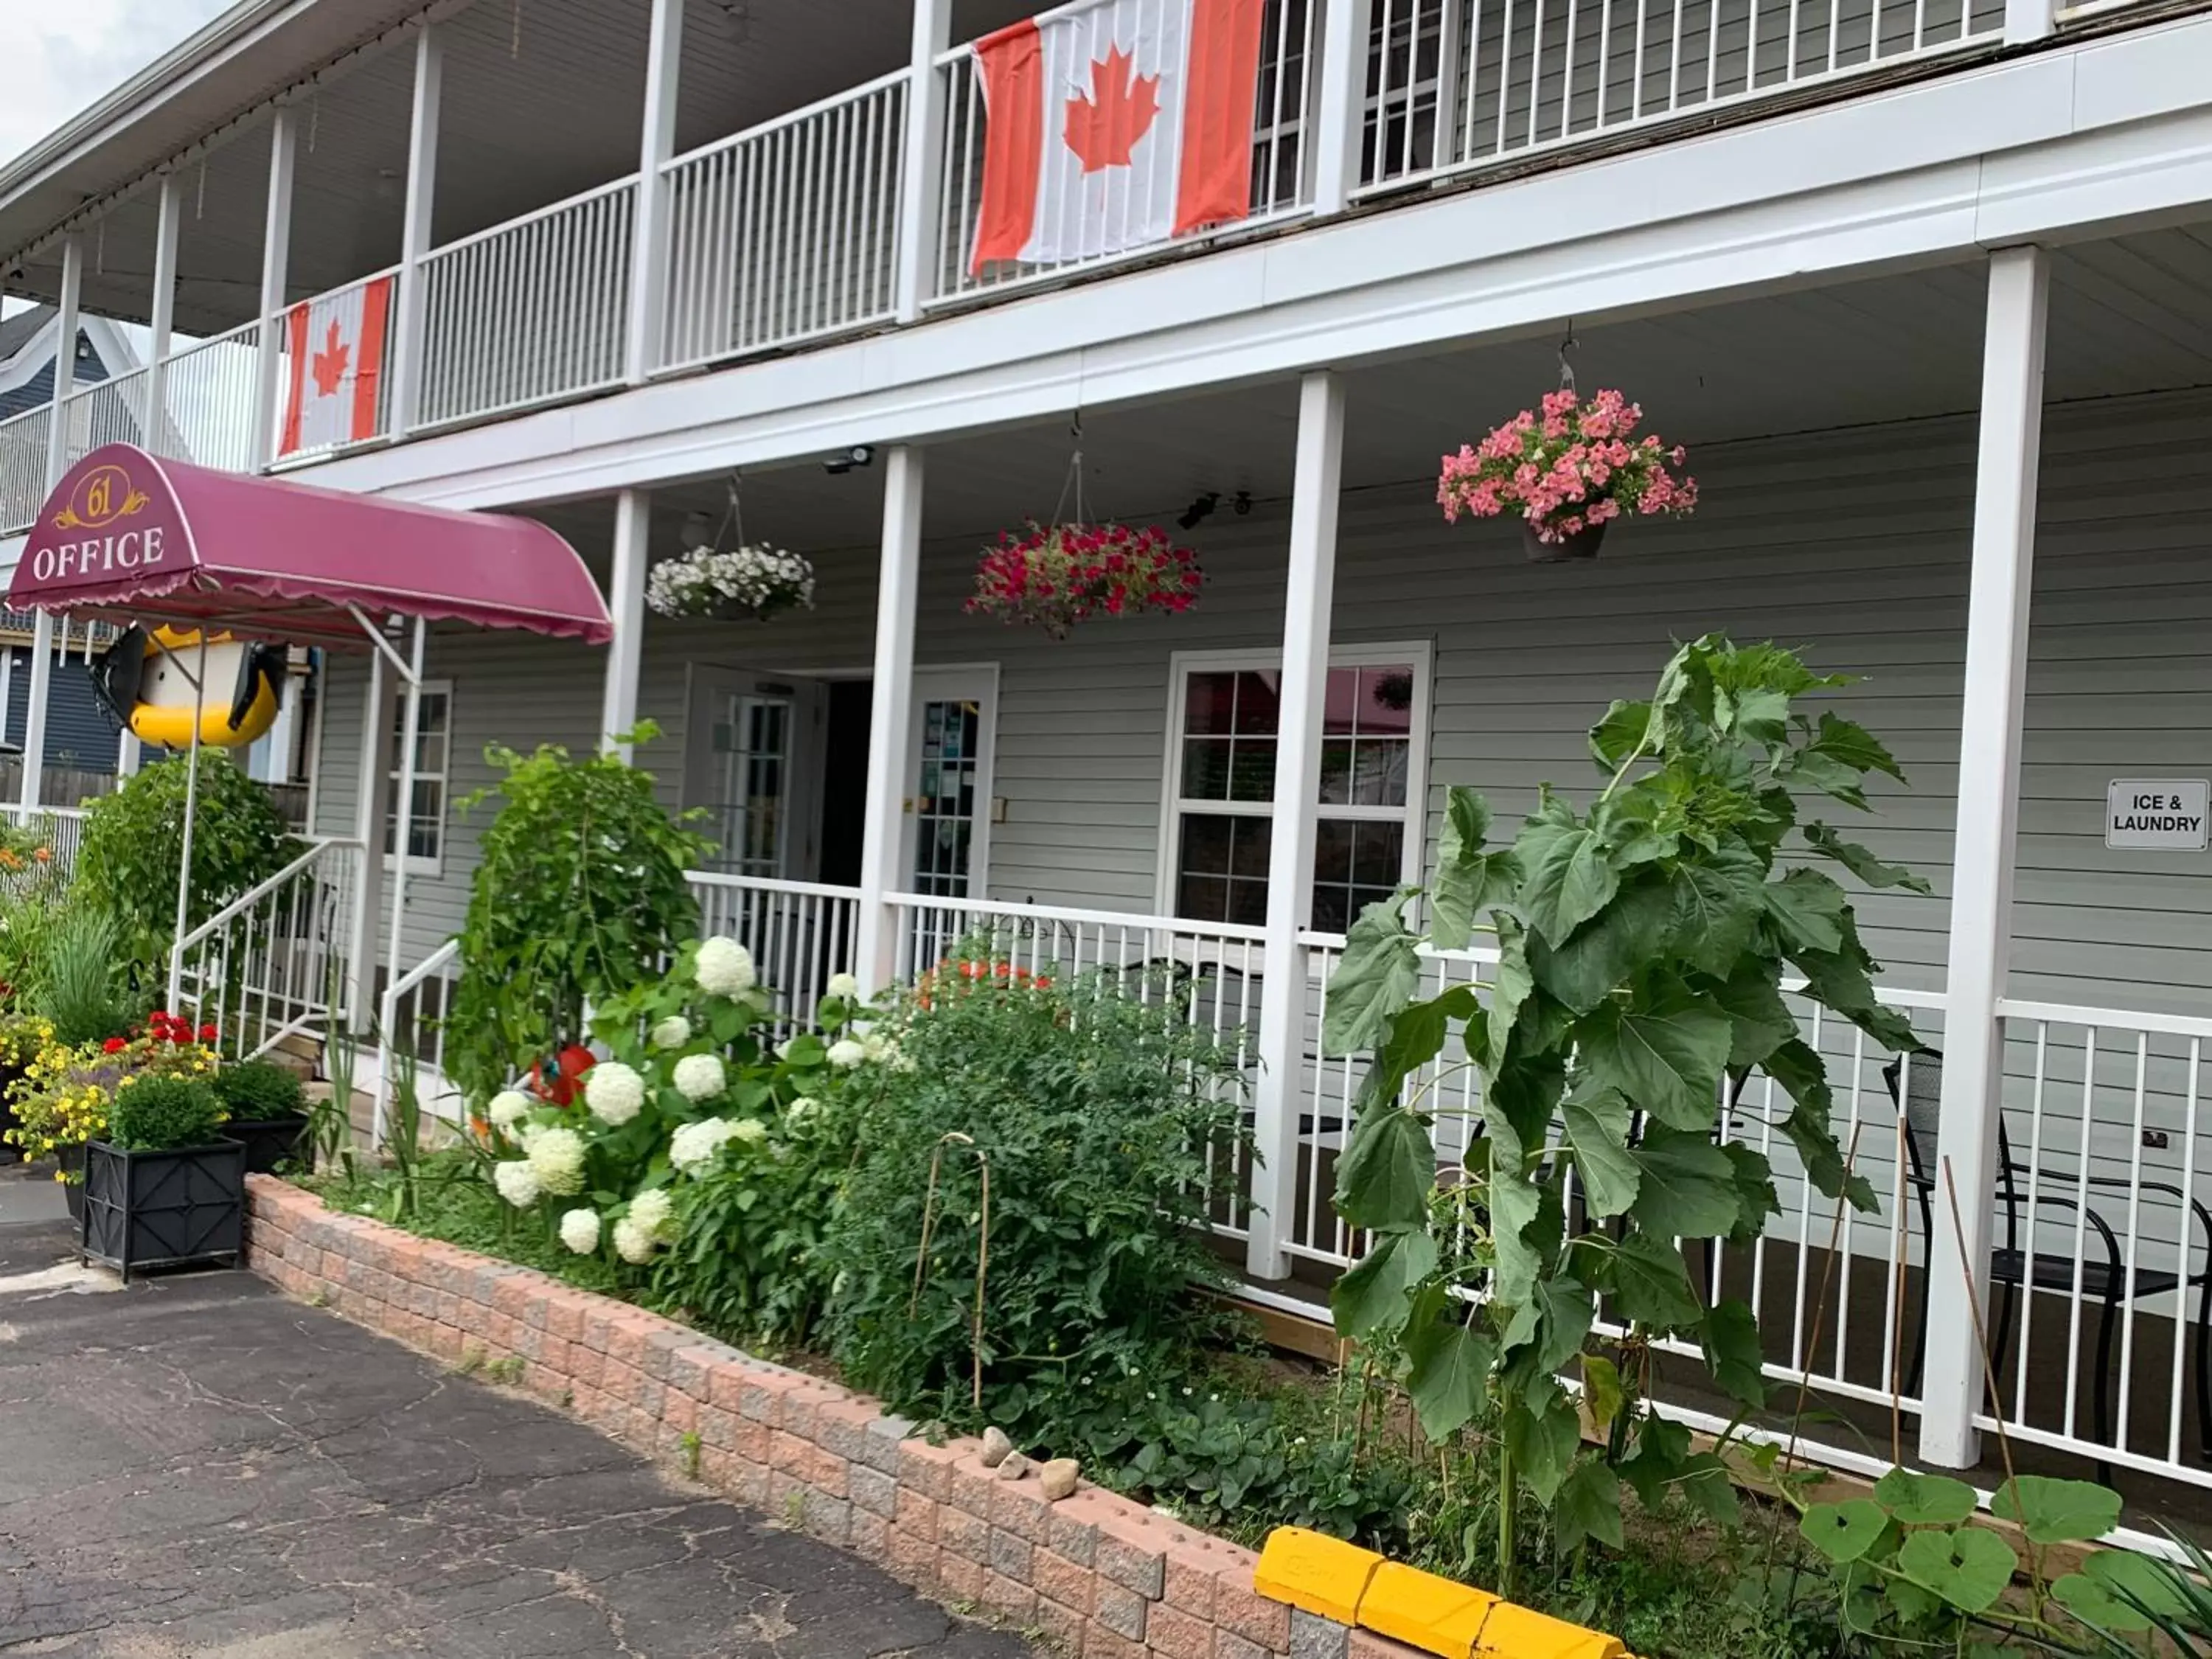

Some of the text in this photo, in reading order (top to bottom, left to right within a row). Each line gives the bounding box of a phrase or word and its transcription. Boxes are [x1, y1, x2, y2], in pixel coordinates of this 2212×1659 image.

[88, 474, 111, 517] 61
[33, 526, 164, 581] OFFICE
[2133, 795, 2182, 810] ICE &
[2114, 815, 2201, 832] LAUNDRY
